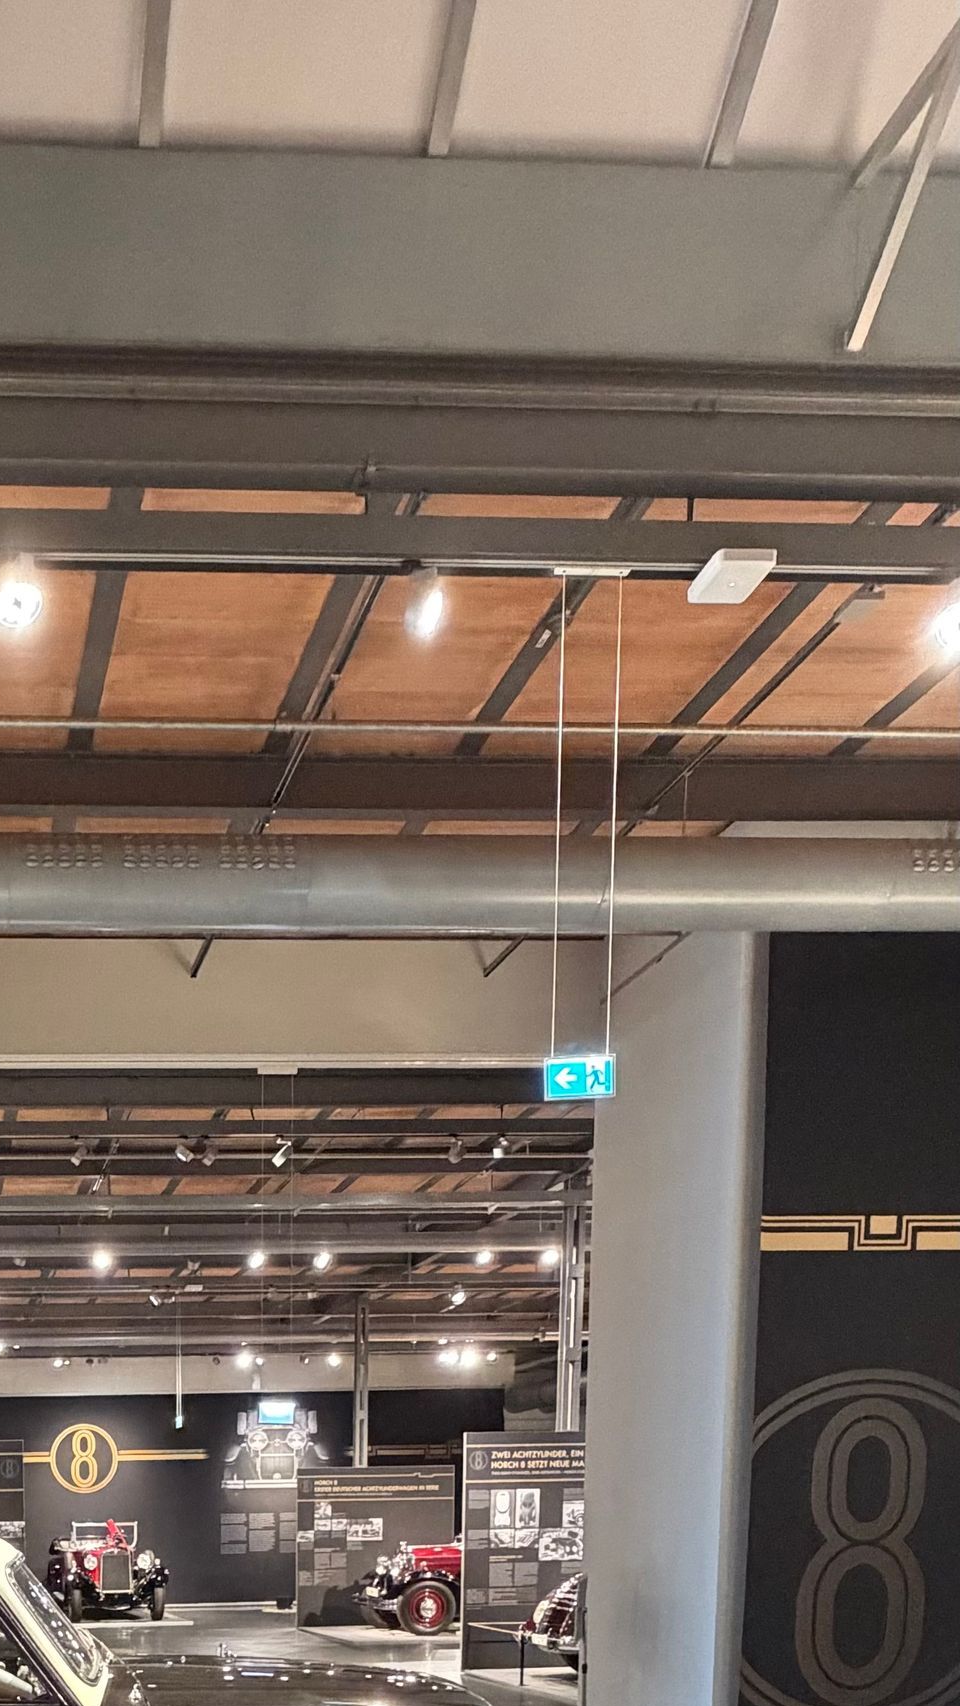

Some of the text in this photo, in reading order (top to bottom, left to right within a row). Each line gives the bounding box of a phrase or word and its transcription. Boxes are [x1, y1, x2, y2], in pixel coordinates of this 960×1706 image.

[70, 1429, 98, 1488] 8
[491, 1451, 511, 1460] ZWEI
[512, 1450, 570, 1459] ACHTZYLINDER,
[491, 1460, 519, 1470] HORCH
[520, 1460, 526, 1469] 8
[527, 1460, 548, 1469] SETZT
[549, 1459, 570, 1468] NEUE
